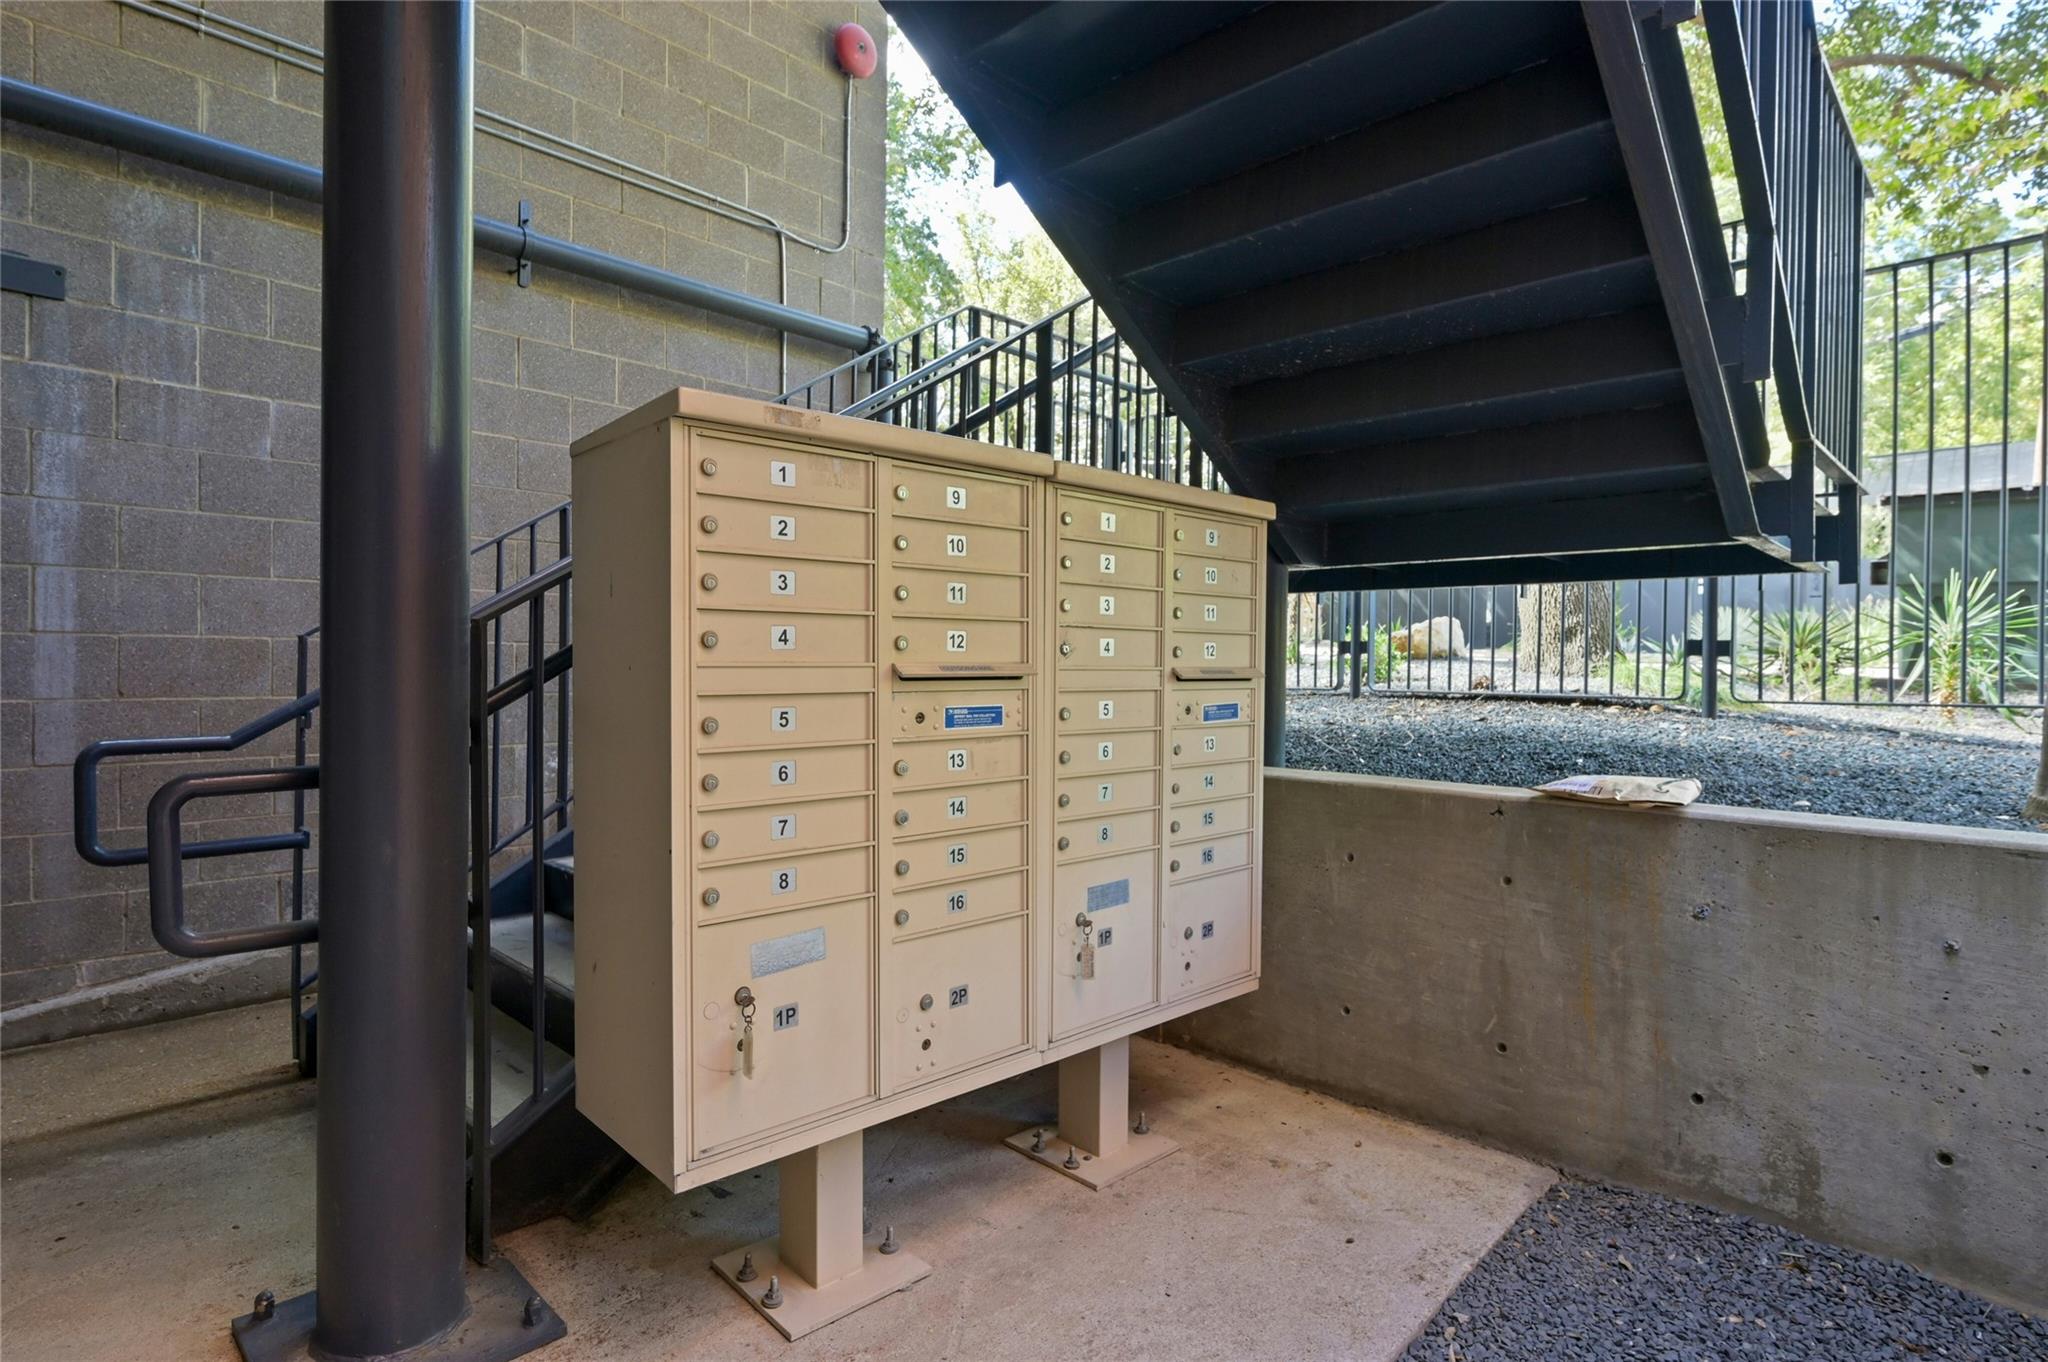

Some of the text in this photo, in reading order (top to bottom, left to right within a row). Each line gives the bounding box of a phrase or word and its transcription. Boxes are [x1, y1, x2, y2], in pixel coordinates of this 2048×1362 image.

[778, 466, 786, 483] 1
[952, 490, 961, 505] 9
[777, 519, 788, 537] 2
[1105, 516, 1111, 529] 1
[1208, 531, 1215, 544] 9
[948, 538, 964, 554] 10
[1104, 557, 1111, 571] 2
[778, 574, 788, 591] 3
[1206, 569, 1216, 582] 10
[949, 585, 963, 601] 11
[1104, 599, 1111, 613] 3
[1206, 607, 1215, 619] 11
[778, 629, 789, 646] 4
[949, 633, 965, 649] 12
[1103, 641, 1111, 654] 4
[1205, 644, 1216, 657] 12
[1103, 703, 1110, 717] 5
[779, 711, 789, 728] 5
[1102, 745, 1109, 759] 6
[1205, 738, 1215, 751] 13
[949, 753, 965, 769] 13
[778, 765, 789, 782] 6
[1204, 775, 1214, 788] 14
[1102, 786, 1109, 799] 7
[949, 800, 965, 816] 14
[1203, 812, 1213, 825] 15
[778, 819, 789, 836] 7
[1101, 827, 1108, 841] 8
[949, 847, 965, 864] 15
[1202, 849, 1213, 863] 16
[779, 872, 789, 890] 8
[949, 894, 965, 911] 16
[1098, 930, 1112, 945] 1P
[1202, 923, 1213, 938] 2P
[951, 988, 968, 1006] 2P
[776, 1007, 797, 1027] 1P
